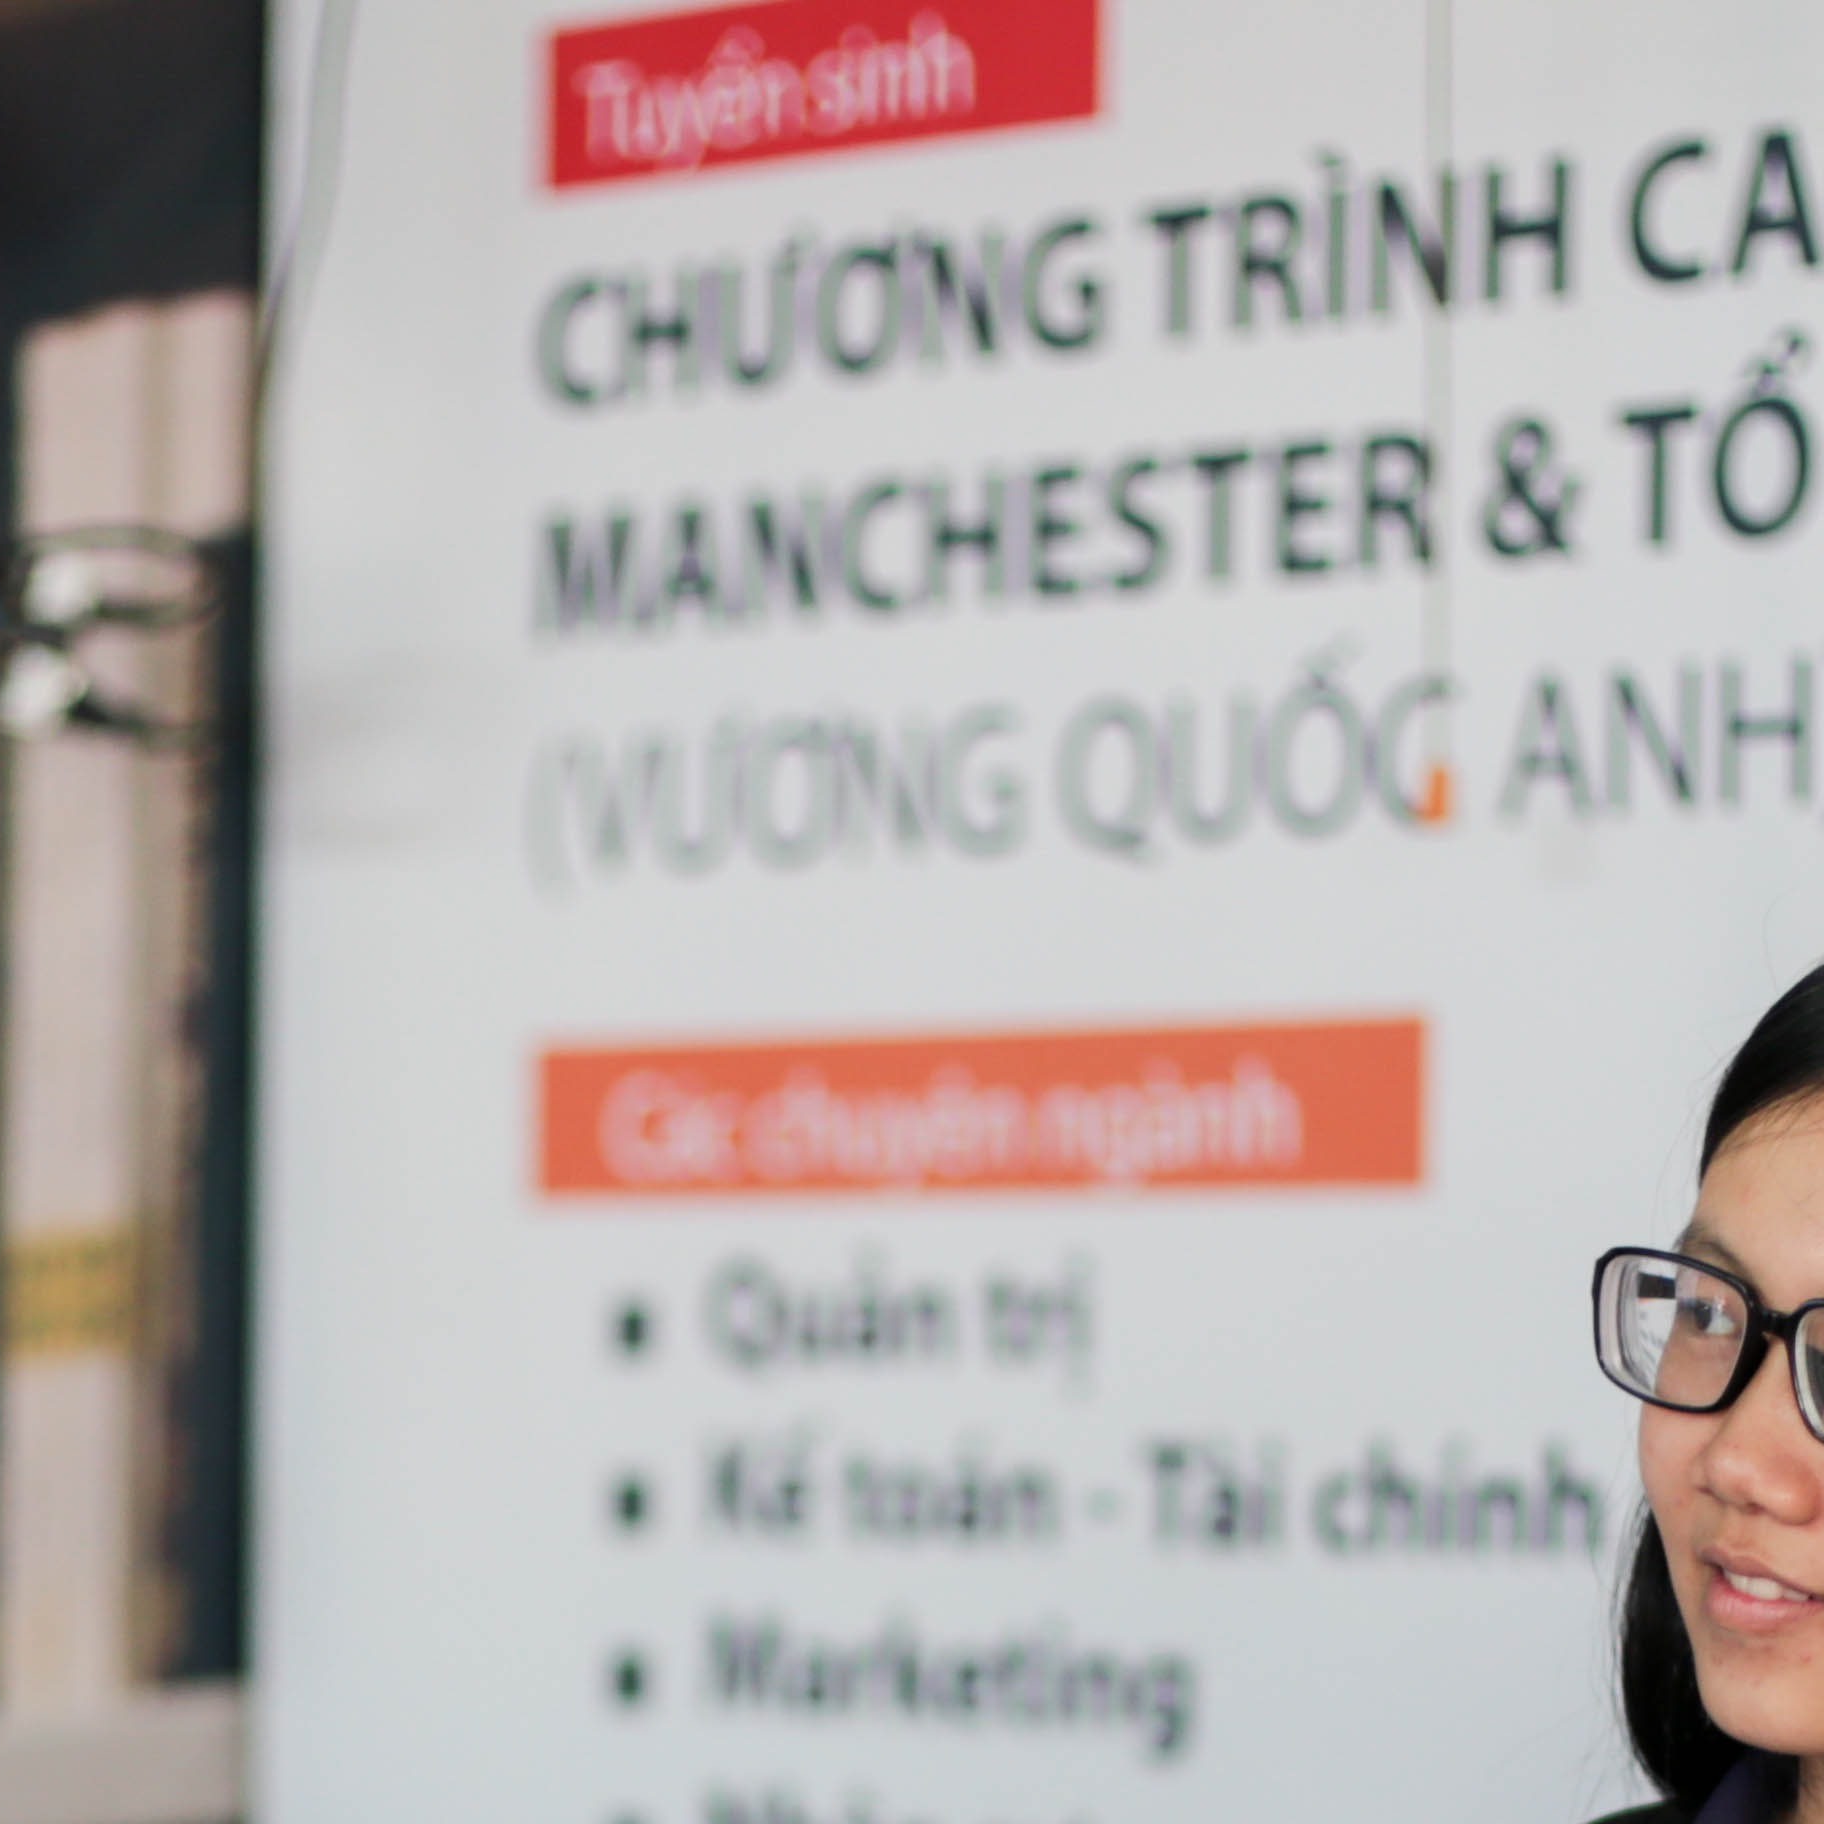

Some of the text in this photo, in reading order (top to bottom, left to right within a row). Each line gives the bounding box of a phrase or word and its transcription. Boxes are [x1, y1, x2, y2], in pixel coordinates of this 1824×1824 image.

[806, 7, 974, 136] sinh
[535, 211, 1106, 410] CHƯƠNG
[1138, 146, 1576, 345] TRÌNH
[535, 432, 1440, 640] MANCHESTER
[1482, 414, 1576, 565] &
[1617, 328, 1816, 550] TỔ
[526, 695, 1028, 897] (VƯƠNG
[703, 1610, 1200, 1764] Marketing
